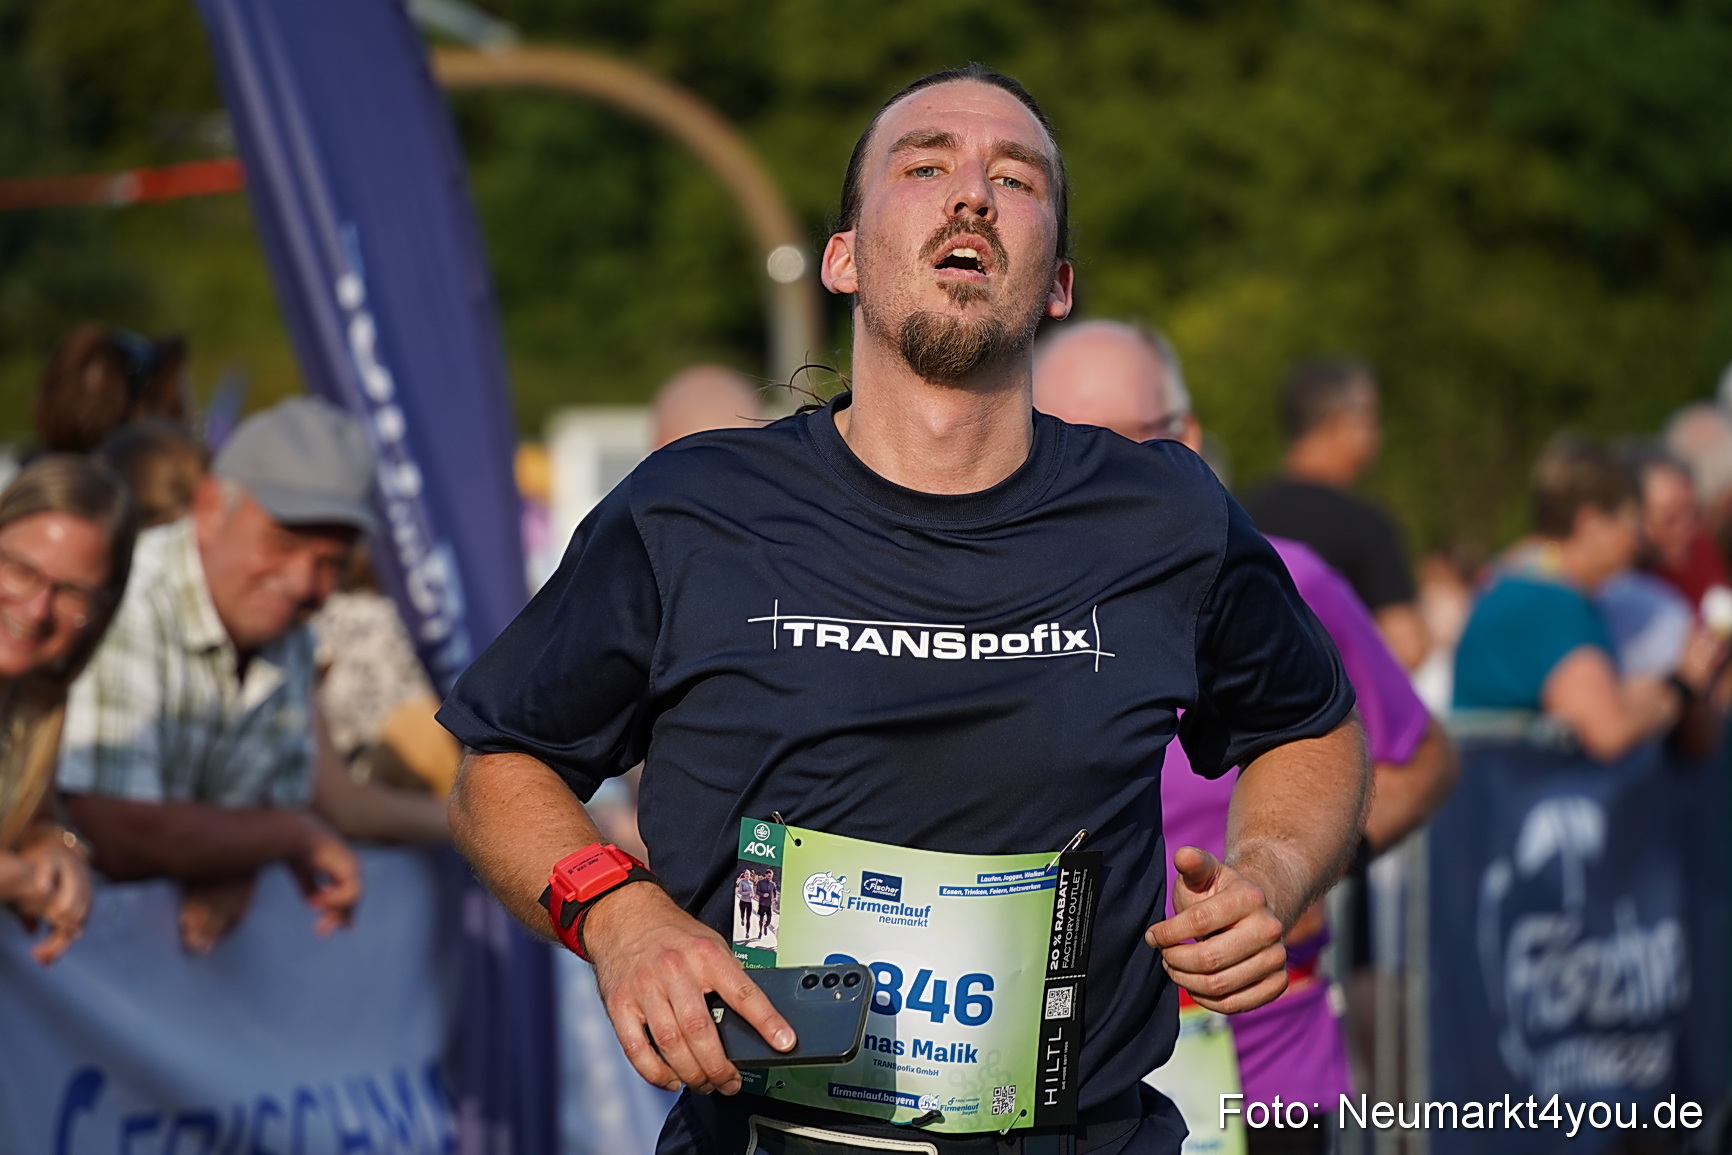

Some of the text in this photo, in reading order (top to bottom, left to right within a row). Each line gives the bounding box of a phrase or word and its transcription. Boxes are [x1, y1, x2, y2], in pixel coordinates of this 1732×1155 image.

[782, 622, 1091, 660] TRANSpofix
[744, 841, 776, 859] AOK
[942, 883, 1041, 896] Essen, Trinken, Feiern, Netzwerken
[980, 875, 1002, 883] Laufen,
[847, 896, 931, 918] Firmenlauf
[879, 915, 928, 927] neumarkt
[1050, 868, 1070, 971] 20 % RABATT
[1062, 869, 1081, 969] FACTORY OUTLET
[824, 953, 995, 1026] 846
[864, 1033, 979, 1064] nas Malik
[873, 1058, 939, 1077] TRANSpofix GmbH
[1043, 1027, 1062, 1105] HILTL
[832, 1085, 915, 1106] firmenlauf.bayern
[939, 1103, 980, 1112] Firmenlauf
